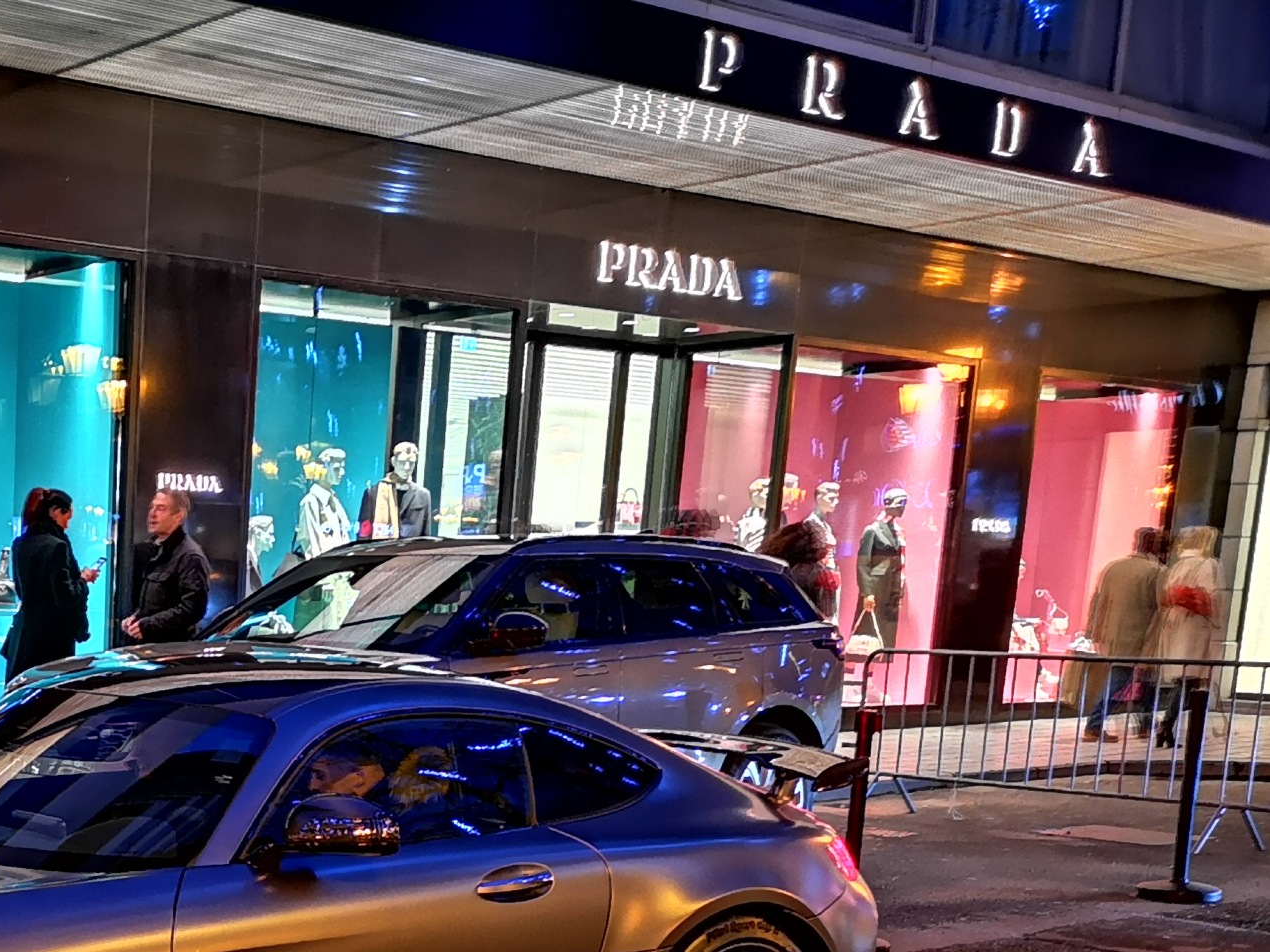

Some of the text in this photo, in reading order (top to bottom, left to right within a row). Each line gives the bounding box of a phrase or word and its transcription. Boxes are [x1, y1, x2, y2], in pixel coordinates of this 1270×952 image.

[698, 27, 1112, 178] PRADA
[597, 239, 744, 302] PRADA
[157, 472, 224, 494] PRADA
